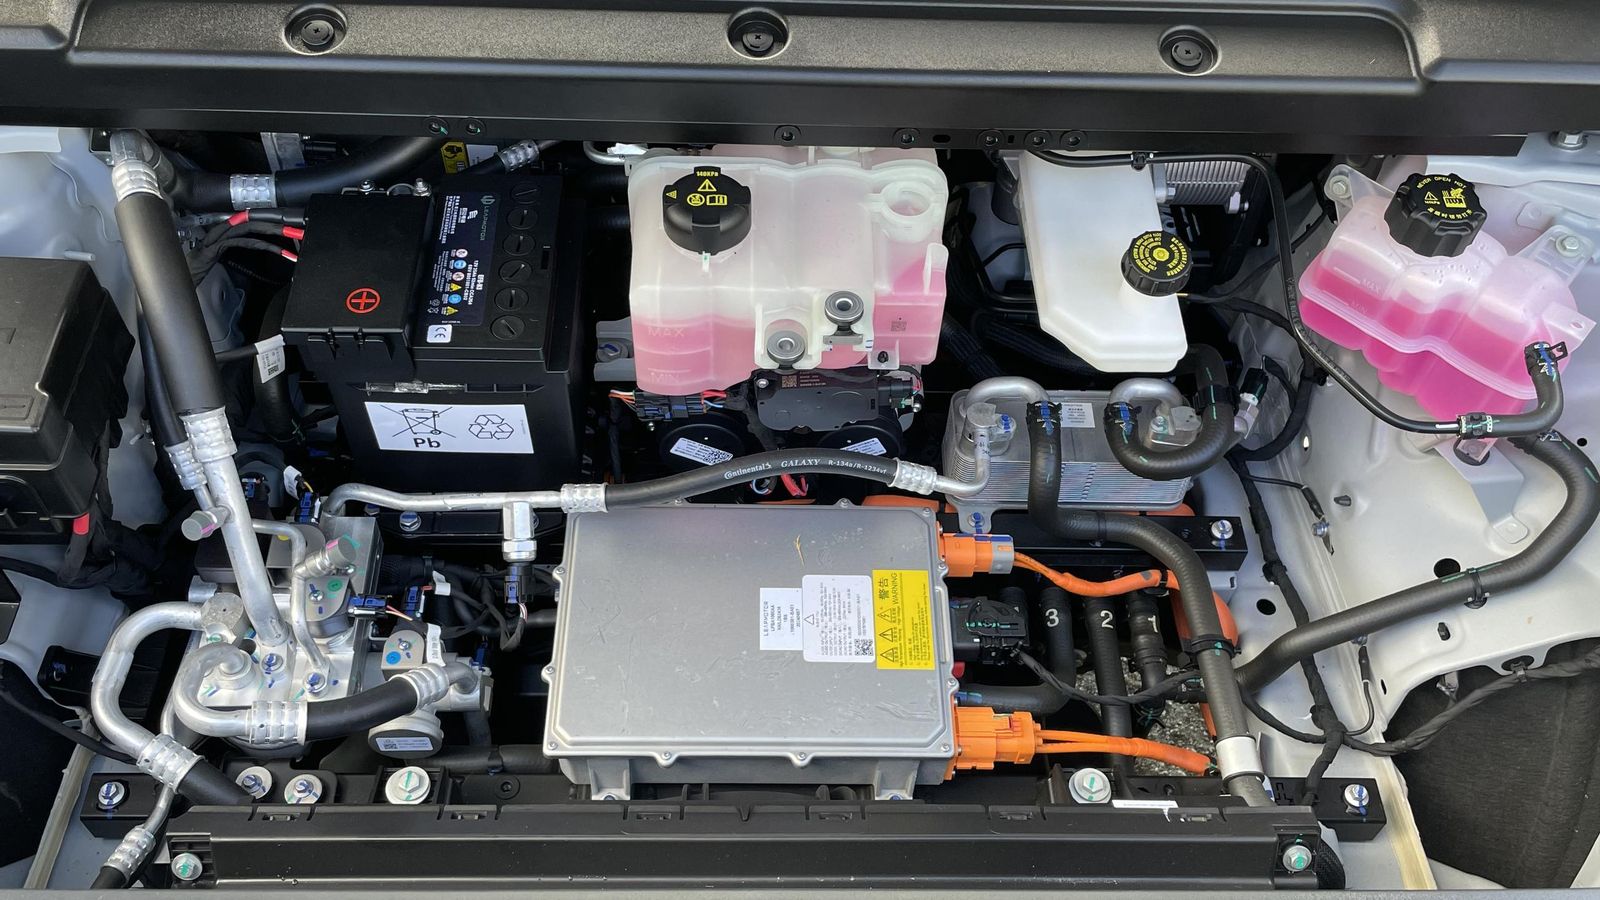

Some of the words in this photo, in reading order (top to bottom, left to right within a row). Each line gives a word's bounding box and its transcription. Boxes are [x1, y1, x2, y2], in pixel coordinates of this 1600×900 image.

[1416, 177, 1431, 189] NEVER
[1454, 180, 1467, 189] HOT
[647, 327, 685, 336] MAX
[648, 372, 680, 384] MIN
[413, 437, 441, 449] Pb
[724, 464, 764, 480] Continental
[781, 459, 821, 468] GALAXY
[878, 577, 889, 600] 警告
[1045, 608, 1060, 628] 3
[1100, 610, 1115, 630] 2
[1148, 615, 1159, 634] 1
